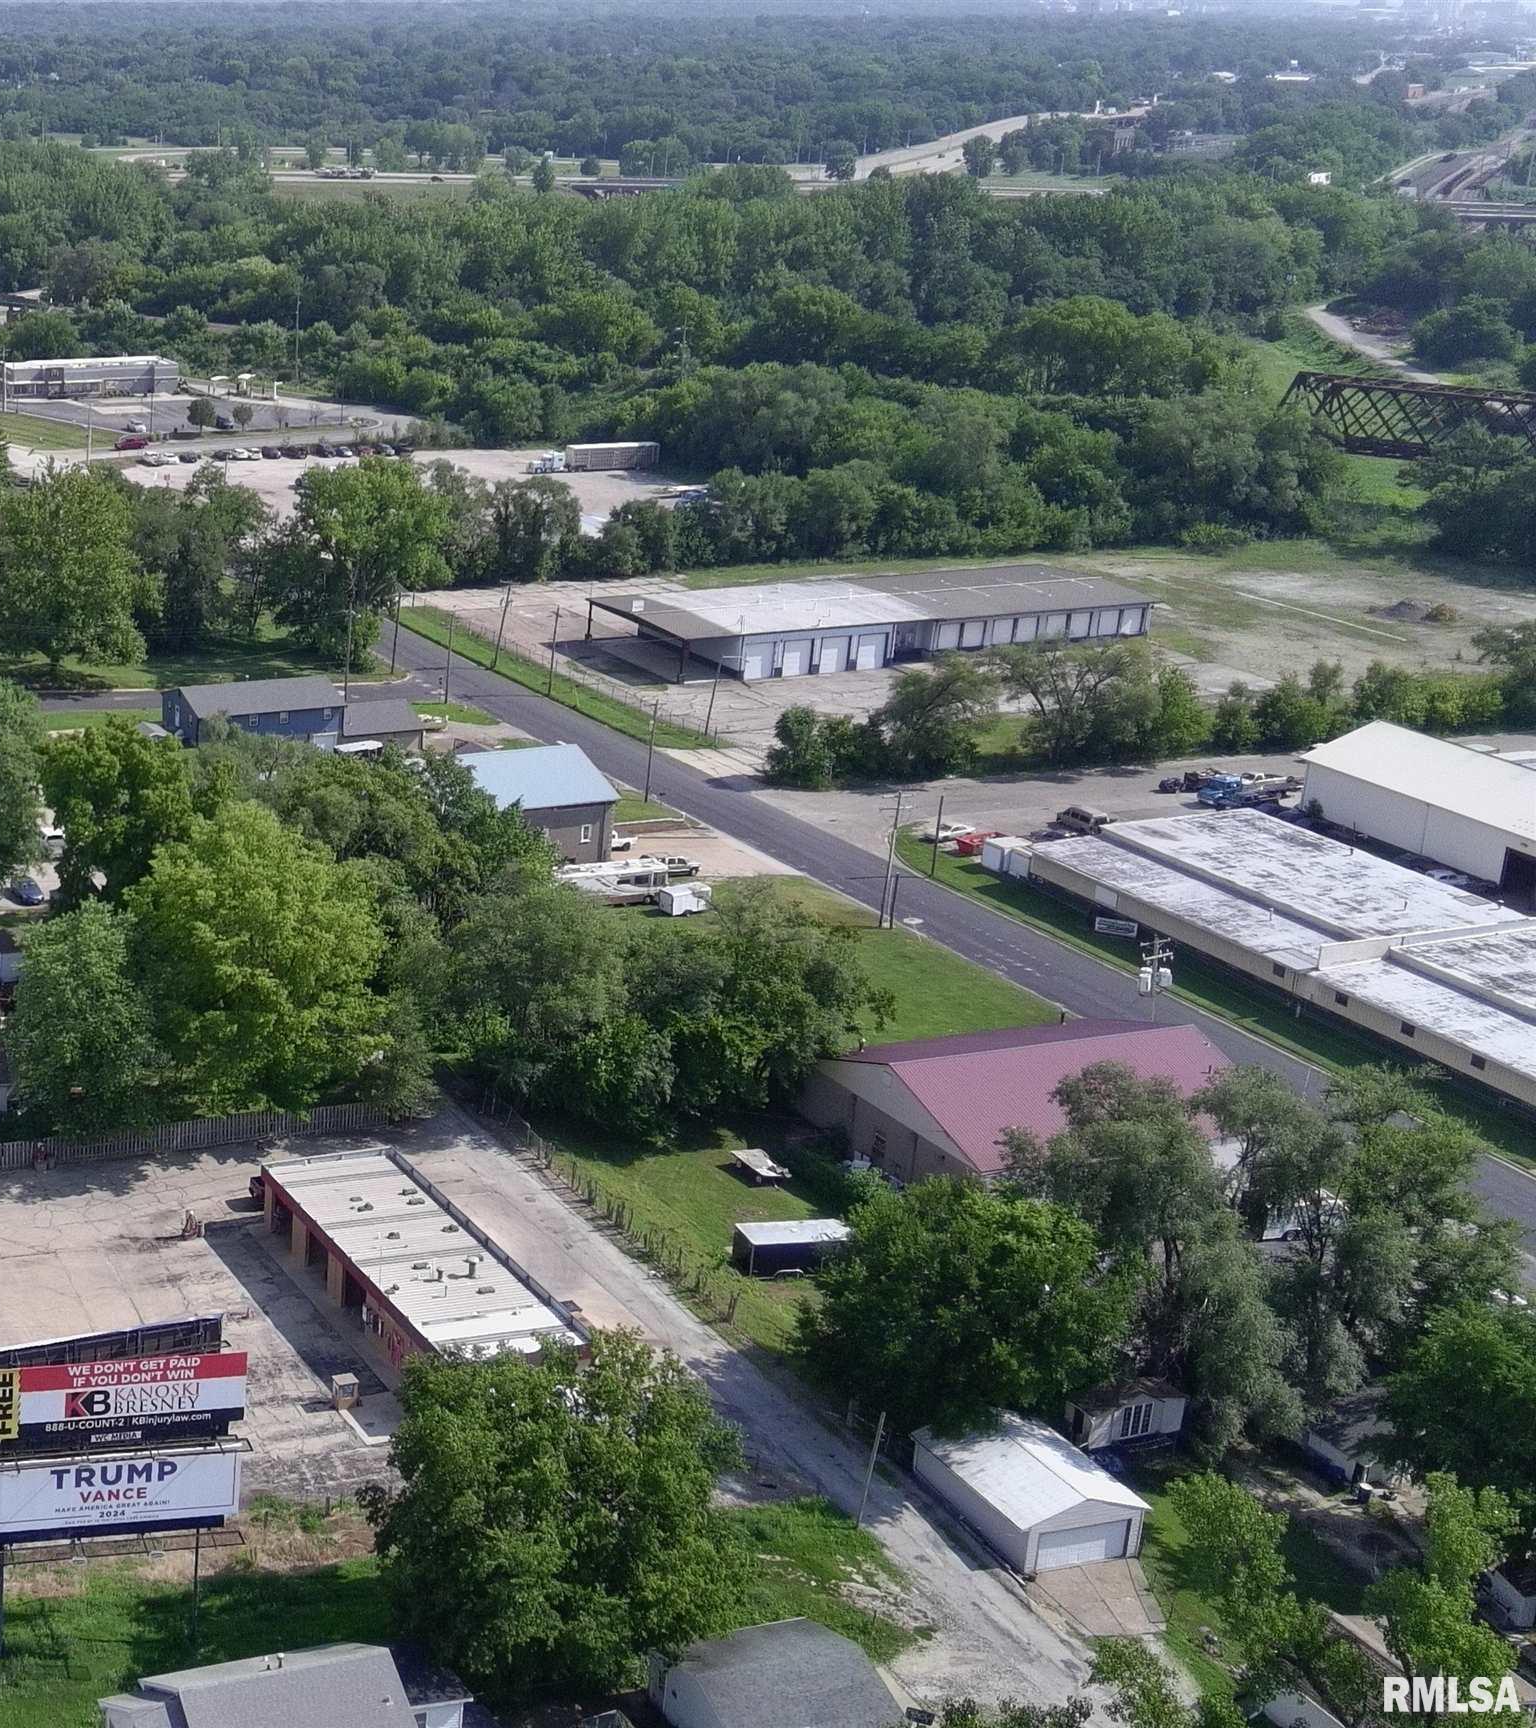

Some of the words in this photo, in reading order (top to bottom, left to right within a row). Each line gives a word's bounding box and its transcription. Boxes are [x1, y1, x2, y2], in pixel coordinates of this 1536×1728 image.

[68, 1366, 91, 1376] WE
[94, 1362, 136, 1374] DON'T
[140, 1359, 166, 1370] GET
[169, 1357, 201, 1369] PAID
[73, 1377, 86, 1387] IF
[89, 1374, 119, 1386] YOU
[121, 1371, 163, 1383] DON'T
[167, 1369, 194, 1379] WIN
[115, 1382, 200, 1400] KANOSKI
[65, 1390, 110, 1418] KB
[115, 1395, 200, 1414] BRESNEY
[113, 1431, 139, 1441] MEDIA
[50, 1461, 178, 1489] TRUMP
[80, 1487, 147, 1503] VANCE
[99, 1510, 125, 1518] 2024
